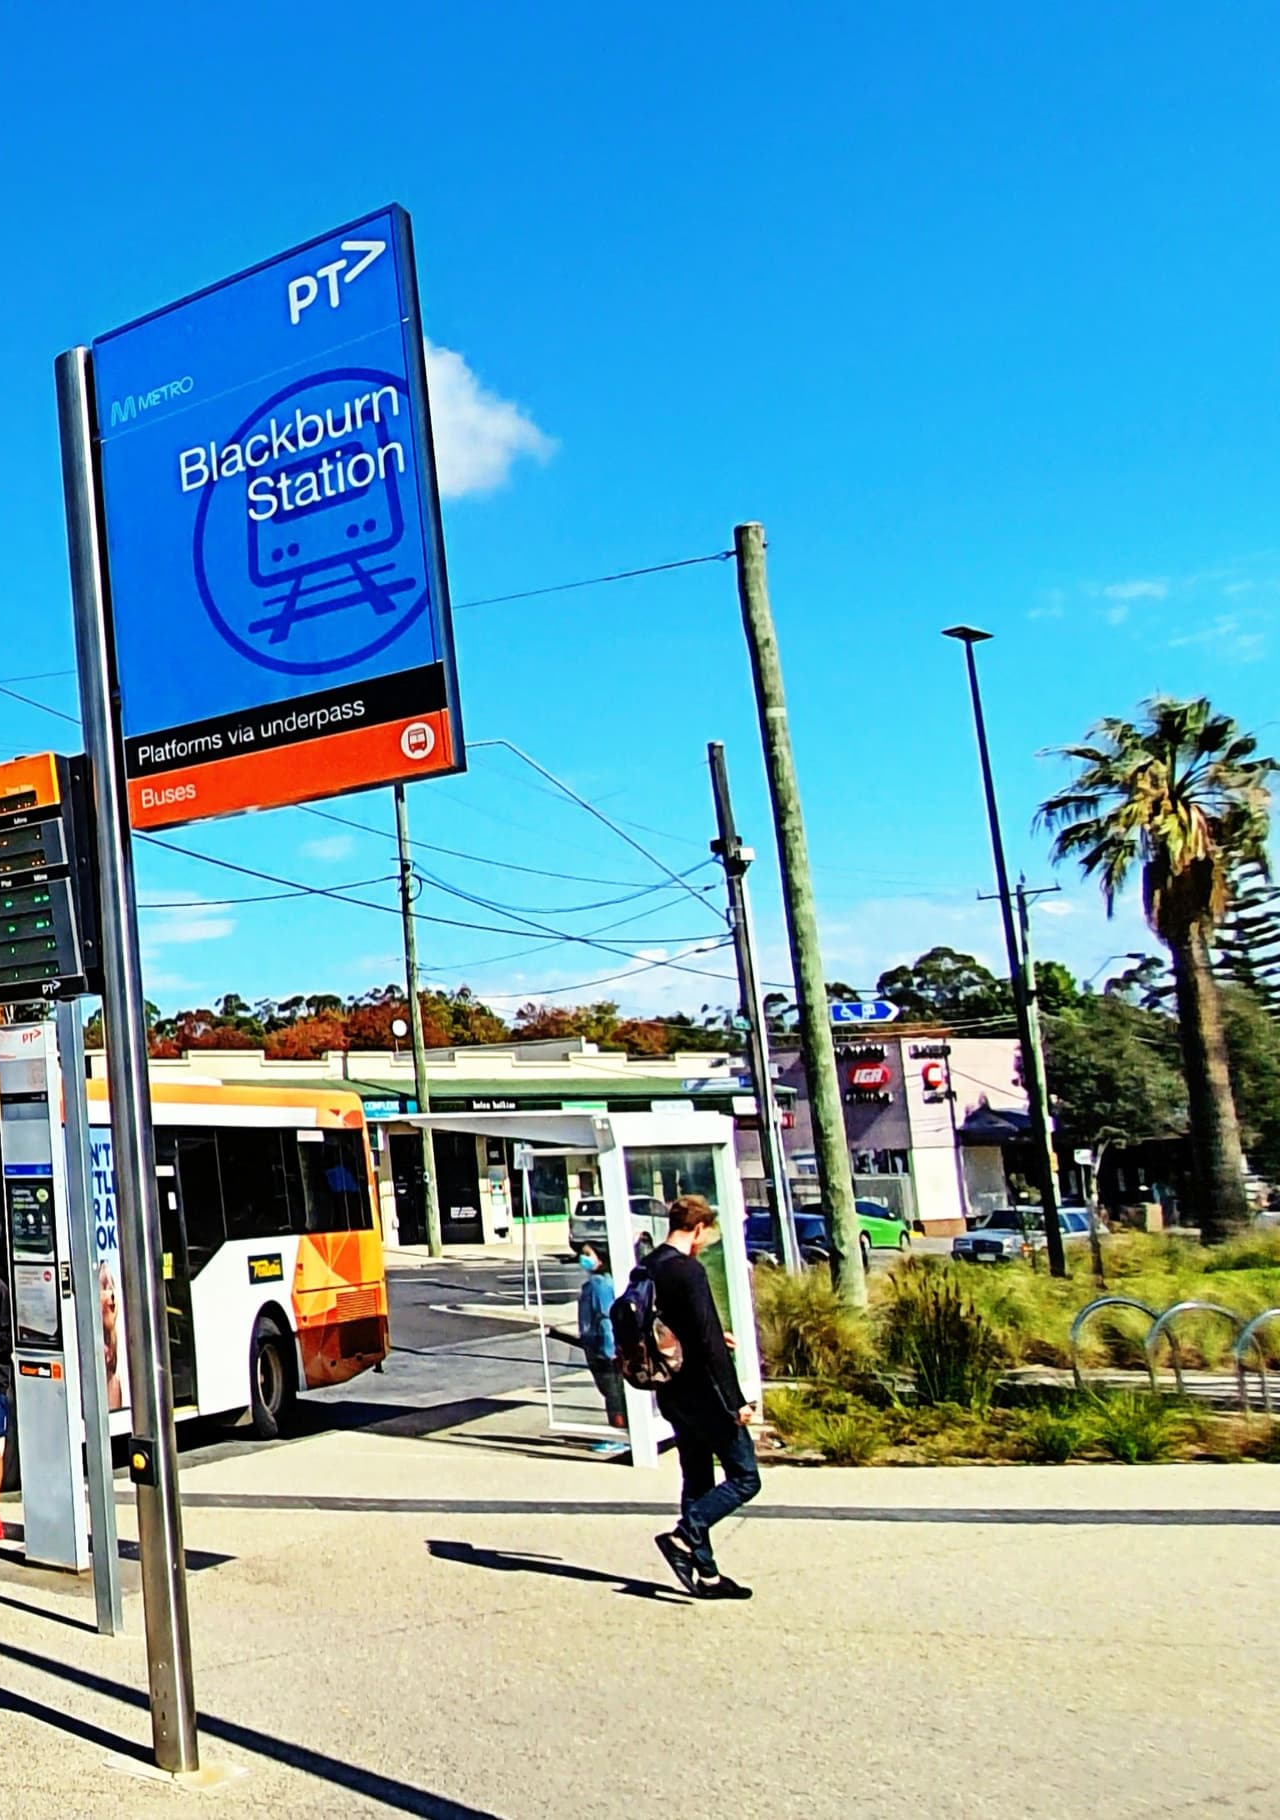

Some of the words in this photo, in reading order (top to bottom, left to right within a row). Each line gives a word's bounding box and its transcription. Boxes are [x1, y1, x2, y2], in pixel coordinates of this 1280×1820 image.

[138, 376, 194, 411] METRO
[179, 385, 399, 492] Blackburn
[247, 442, 405, 521] Station
[138, 732, 223, 766] Platforms
[227, 724, 255, 746] via
[261, 699, 365, 738] underpass
[141, 783, 196, 809] Buses
[853, 1068, 884, 1084] IGA
